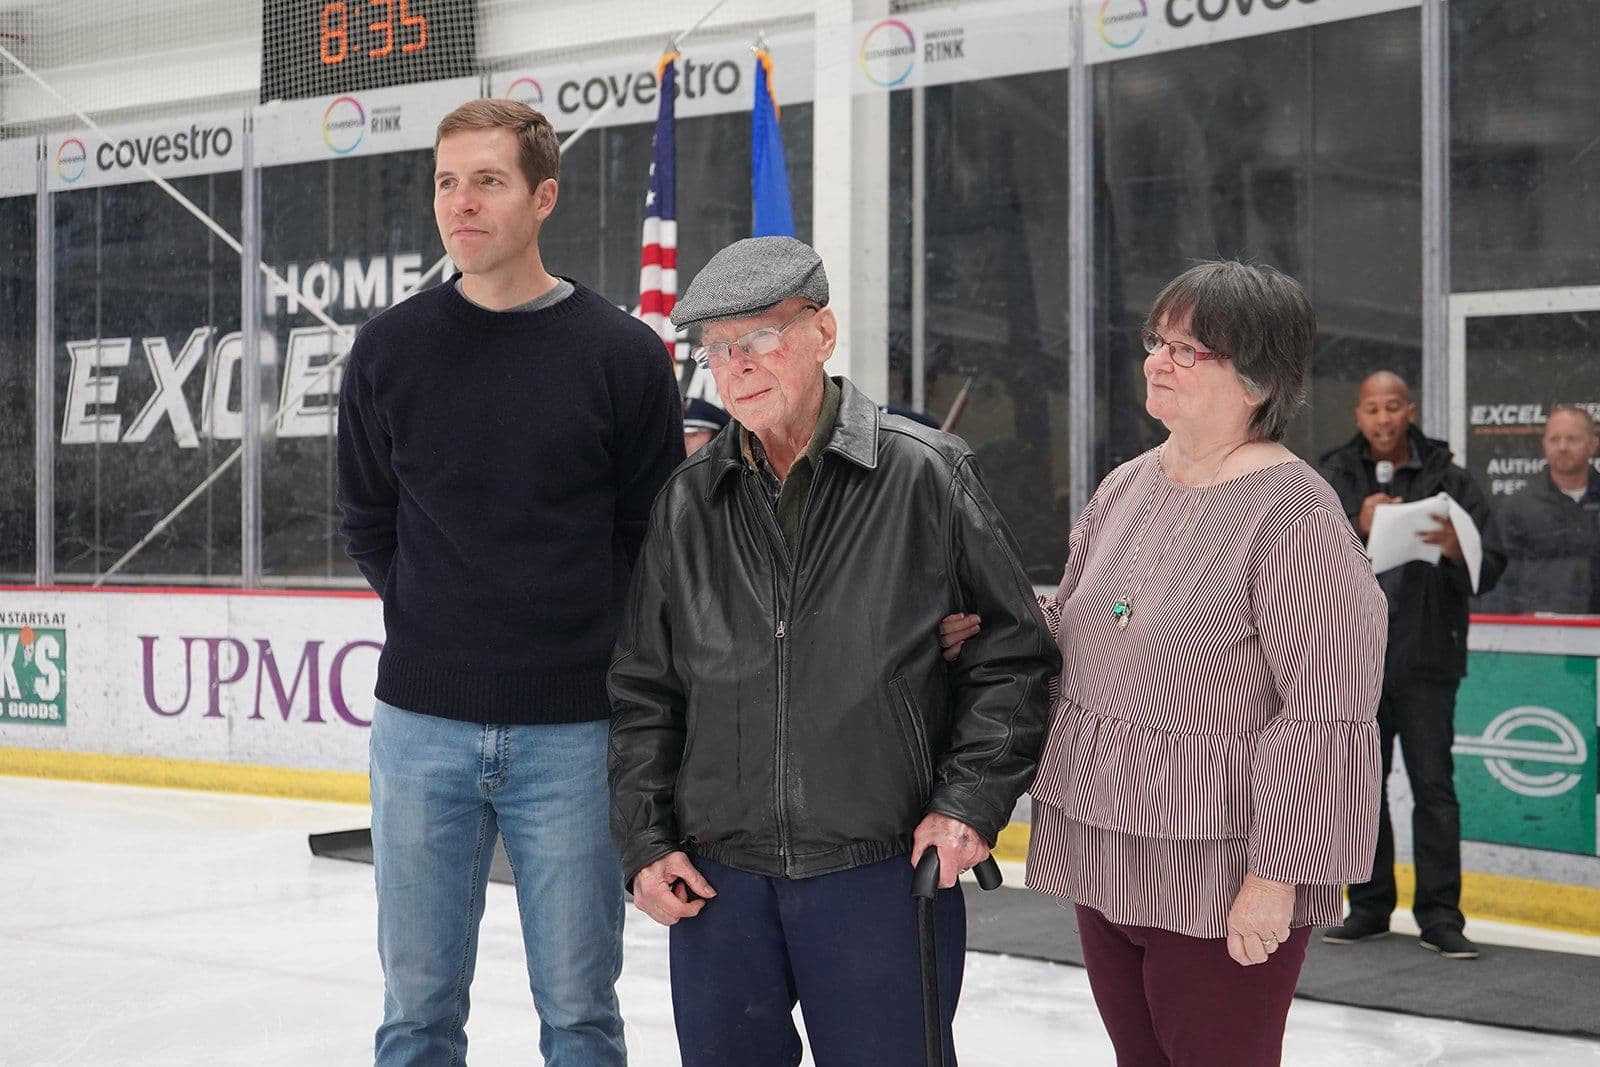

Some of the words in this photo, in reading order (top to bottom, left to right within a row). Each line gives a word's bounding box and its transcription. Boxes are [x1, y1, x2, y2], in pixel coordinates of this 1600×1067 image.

[321, 0, 428, 64] 8:35
[924, 40, 964, 62] RINK
[371, 116, 402, 134] RINK
[96, 125, 233, 171] covestro
[264, 254, 423, 316] HOME
[1470, 403, 1547, 425] EXCEL
[8, 611, 49, 624] STARTS
[52, 613, 66, 625] AT
[138, 636, 384, 727] UPMC
[8, 701, 59, 720] GOODS
